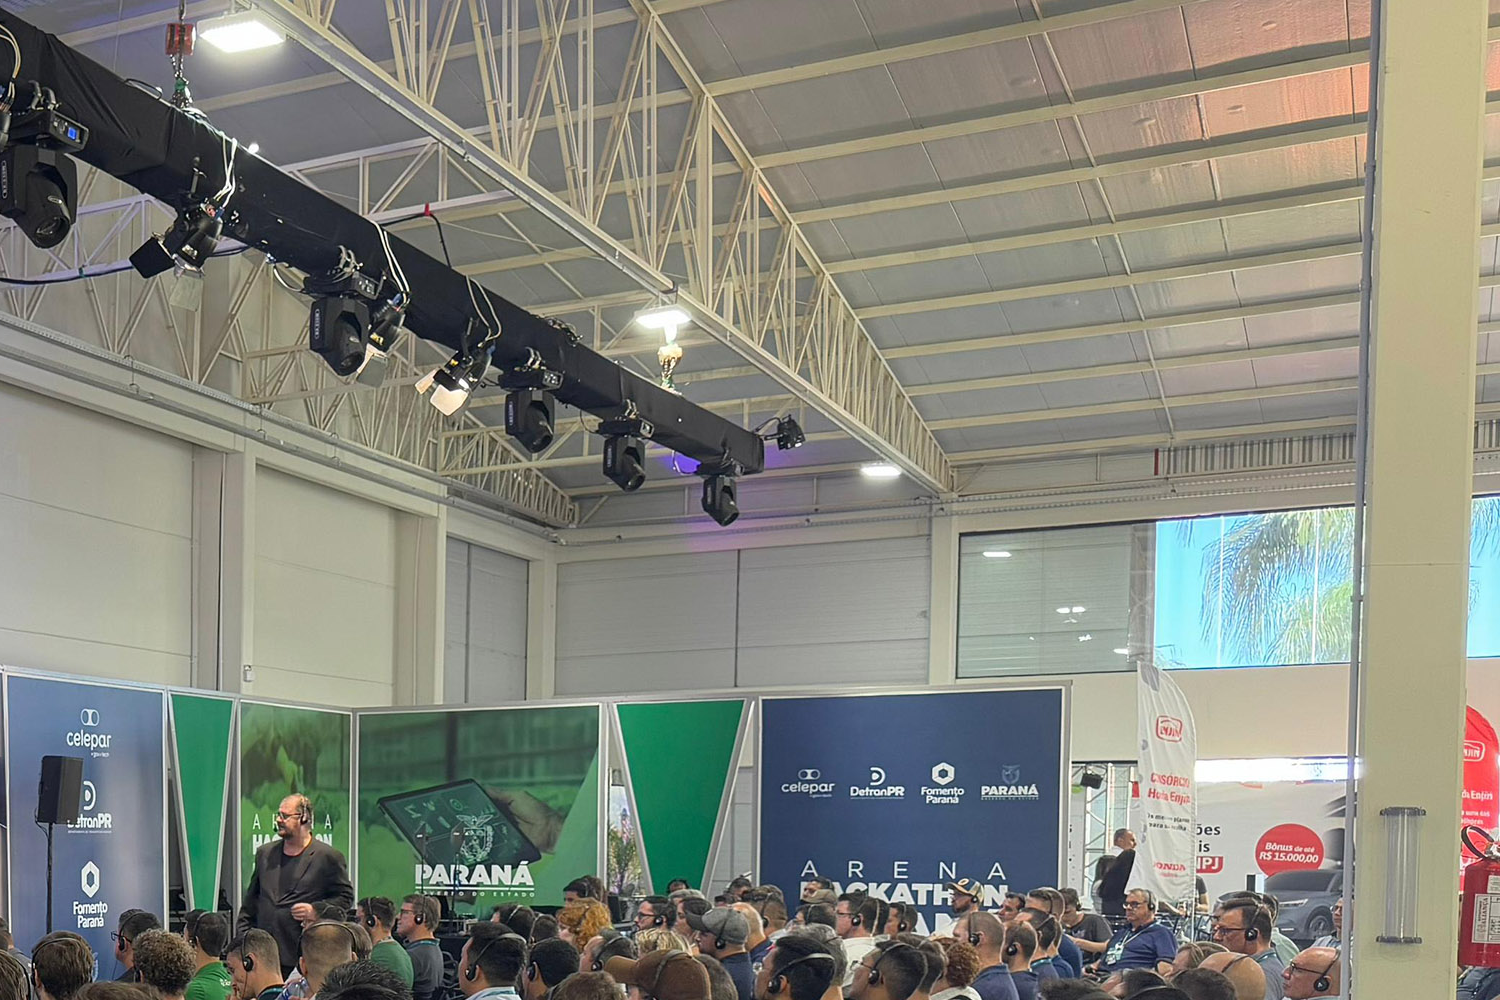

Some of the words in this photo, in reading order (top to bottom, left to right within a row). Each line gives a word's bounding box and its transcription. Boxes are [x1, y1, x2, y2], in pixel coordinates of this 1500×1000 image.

[66, 729, 111, 750] celepar
[781, 782, 835, 794] celepar
[850, 786, 905, 796] DetranPR
[921, 786, 965, 797] Fomento
[981, 783, 1039, 795] PARANÁ
[1265, 842, 1293, 852] Bônus
[1274, 852, 1319, 864] 15.000,00
[415, 860, 534, 886] PARANÁ
[801, 860, 1007, 880] ARENA
[73, 901, 108, 915] Fomento
